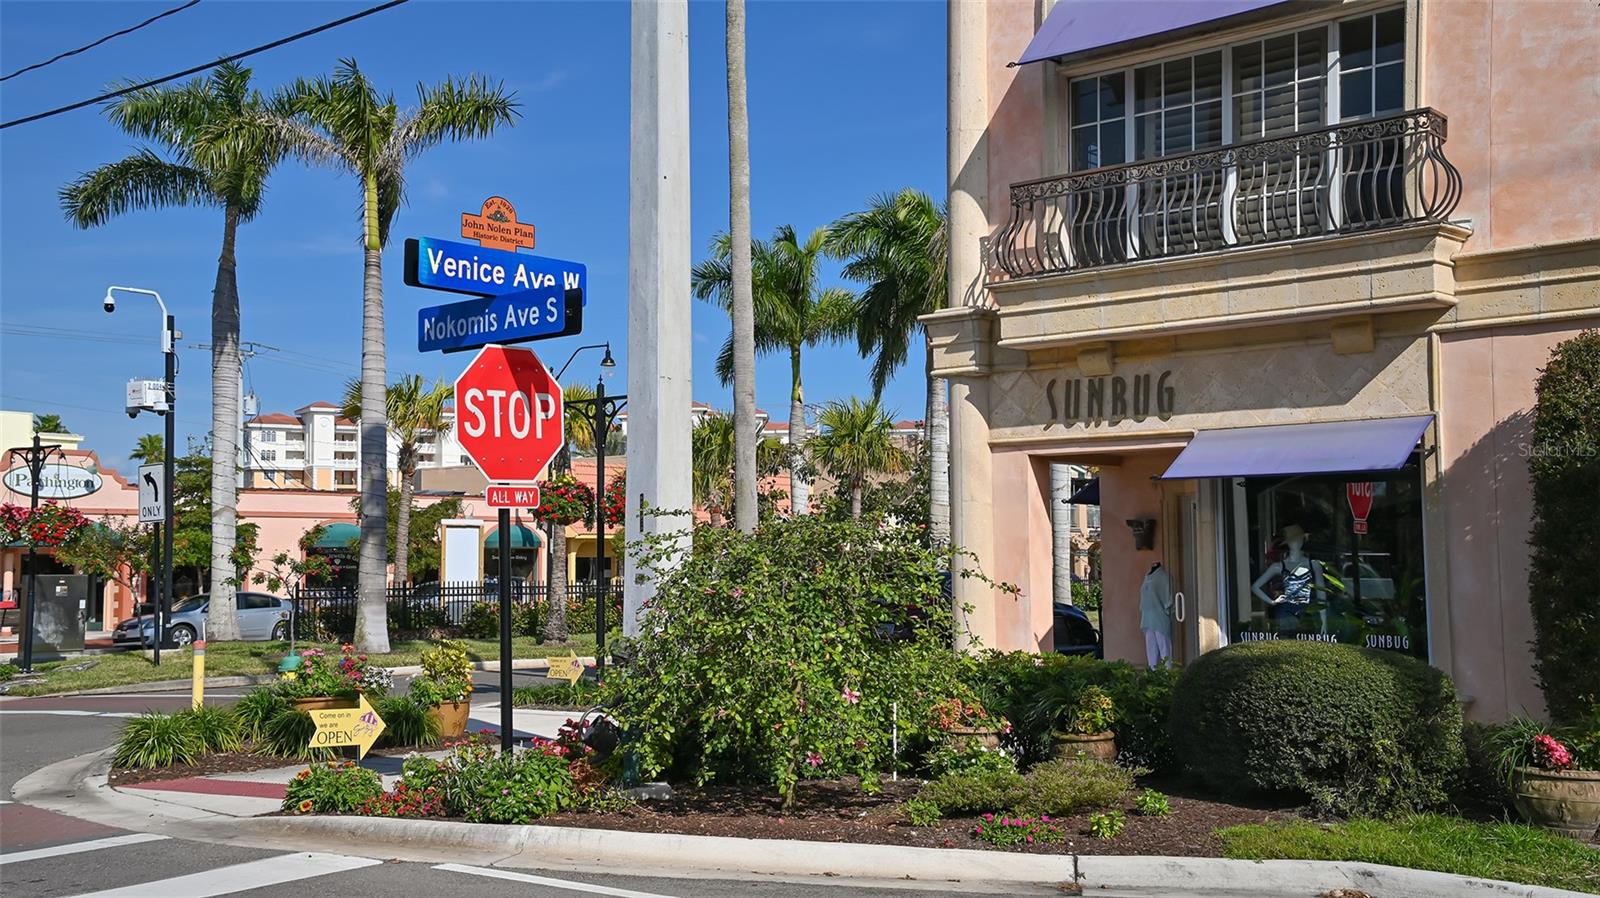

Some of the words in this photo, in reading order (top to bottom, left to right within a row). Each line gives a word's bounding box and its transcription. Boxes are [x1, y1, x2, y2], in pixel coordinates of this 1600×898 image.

[463, 219, 485, 230] John
[487, 223, 512, 235] Nolen
[514, 227, 534, 239] Plan
[473, 231, 499, 241] Historic
[500, 235, 524, 245] District
[427, 248, 505, 285] Venice
[513, 264, 556, 289] Ave
[563, 271, 580, 290] W
[424, 309, 498, 341] Nokomis
[504, 304, 540, 330] Ave
[546, 297, 558, 323] S
[1044, 370, 1175, 427] SUNBUG
[463, 387, 556, 440] STOP
[491, 490, 510, 503] ALL
[514, 490, 534, 503] WAY
[142, 505, 161, 518] ONLY
[1365, 633, 1409, 650] SUNBUG
[550, 669, 568, 677] OPEN
[316, 730, 353, 744] OPEN
